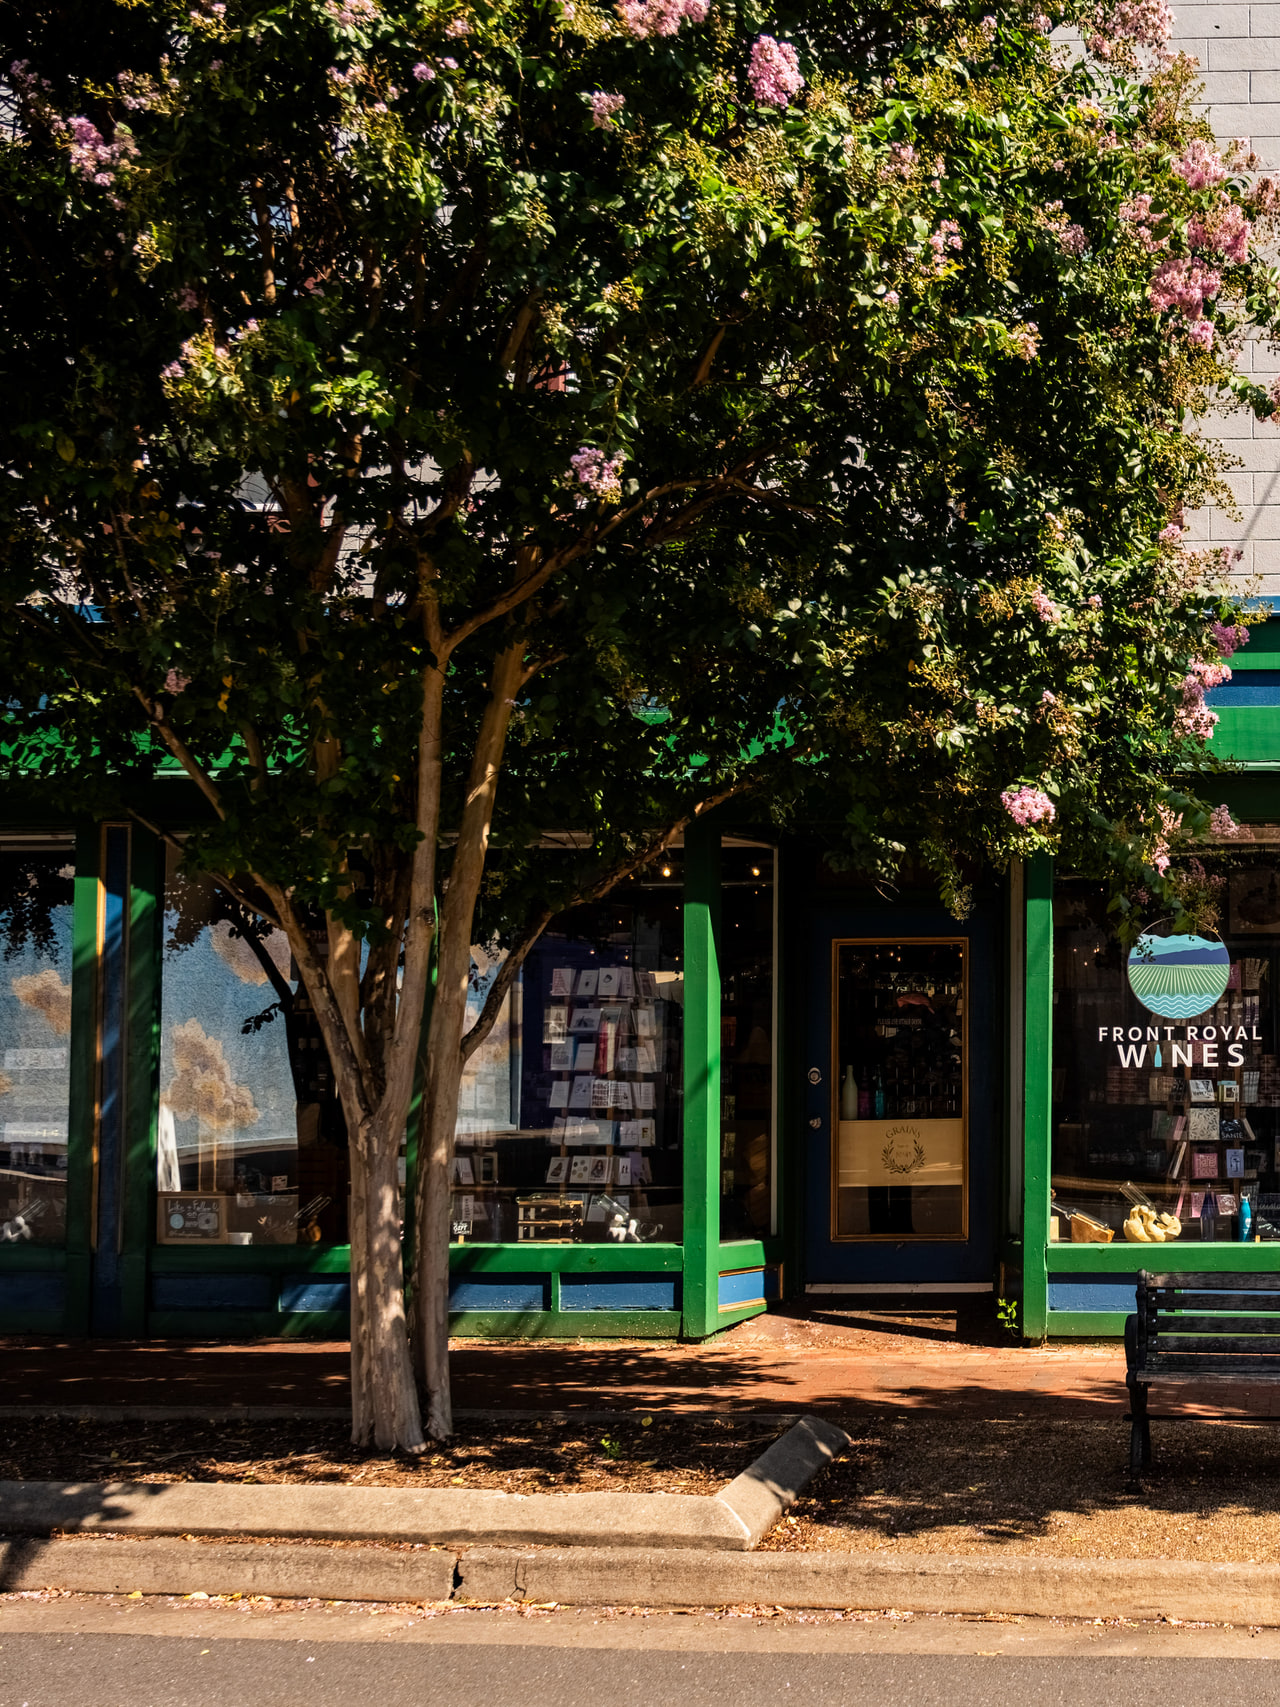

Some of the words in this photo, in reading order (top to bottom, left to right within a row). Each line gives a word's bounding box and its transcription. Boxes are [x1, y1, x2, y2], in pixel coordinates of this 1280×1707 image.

[1098, 1026, 1175, 1042] FRONT
[1187, 1025, 1263, 1041] ROYAL
[1117, 1043, 1245, 1068] WINES
[885, 1125, 921, 1139] GRAINS
